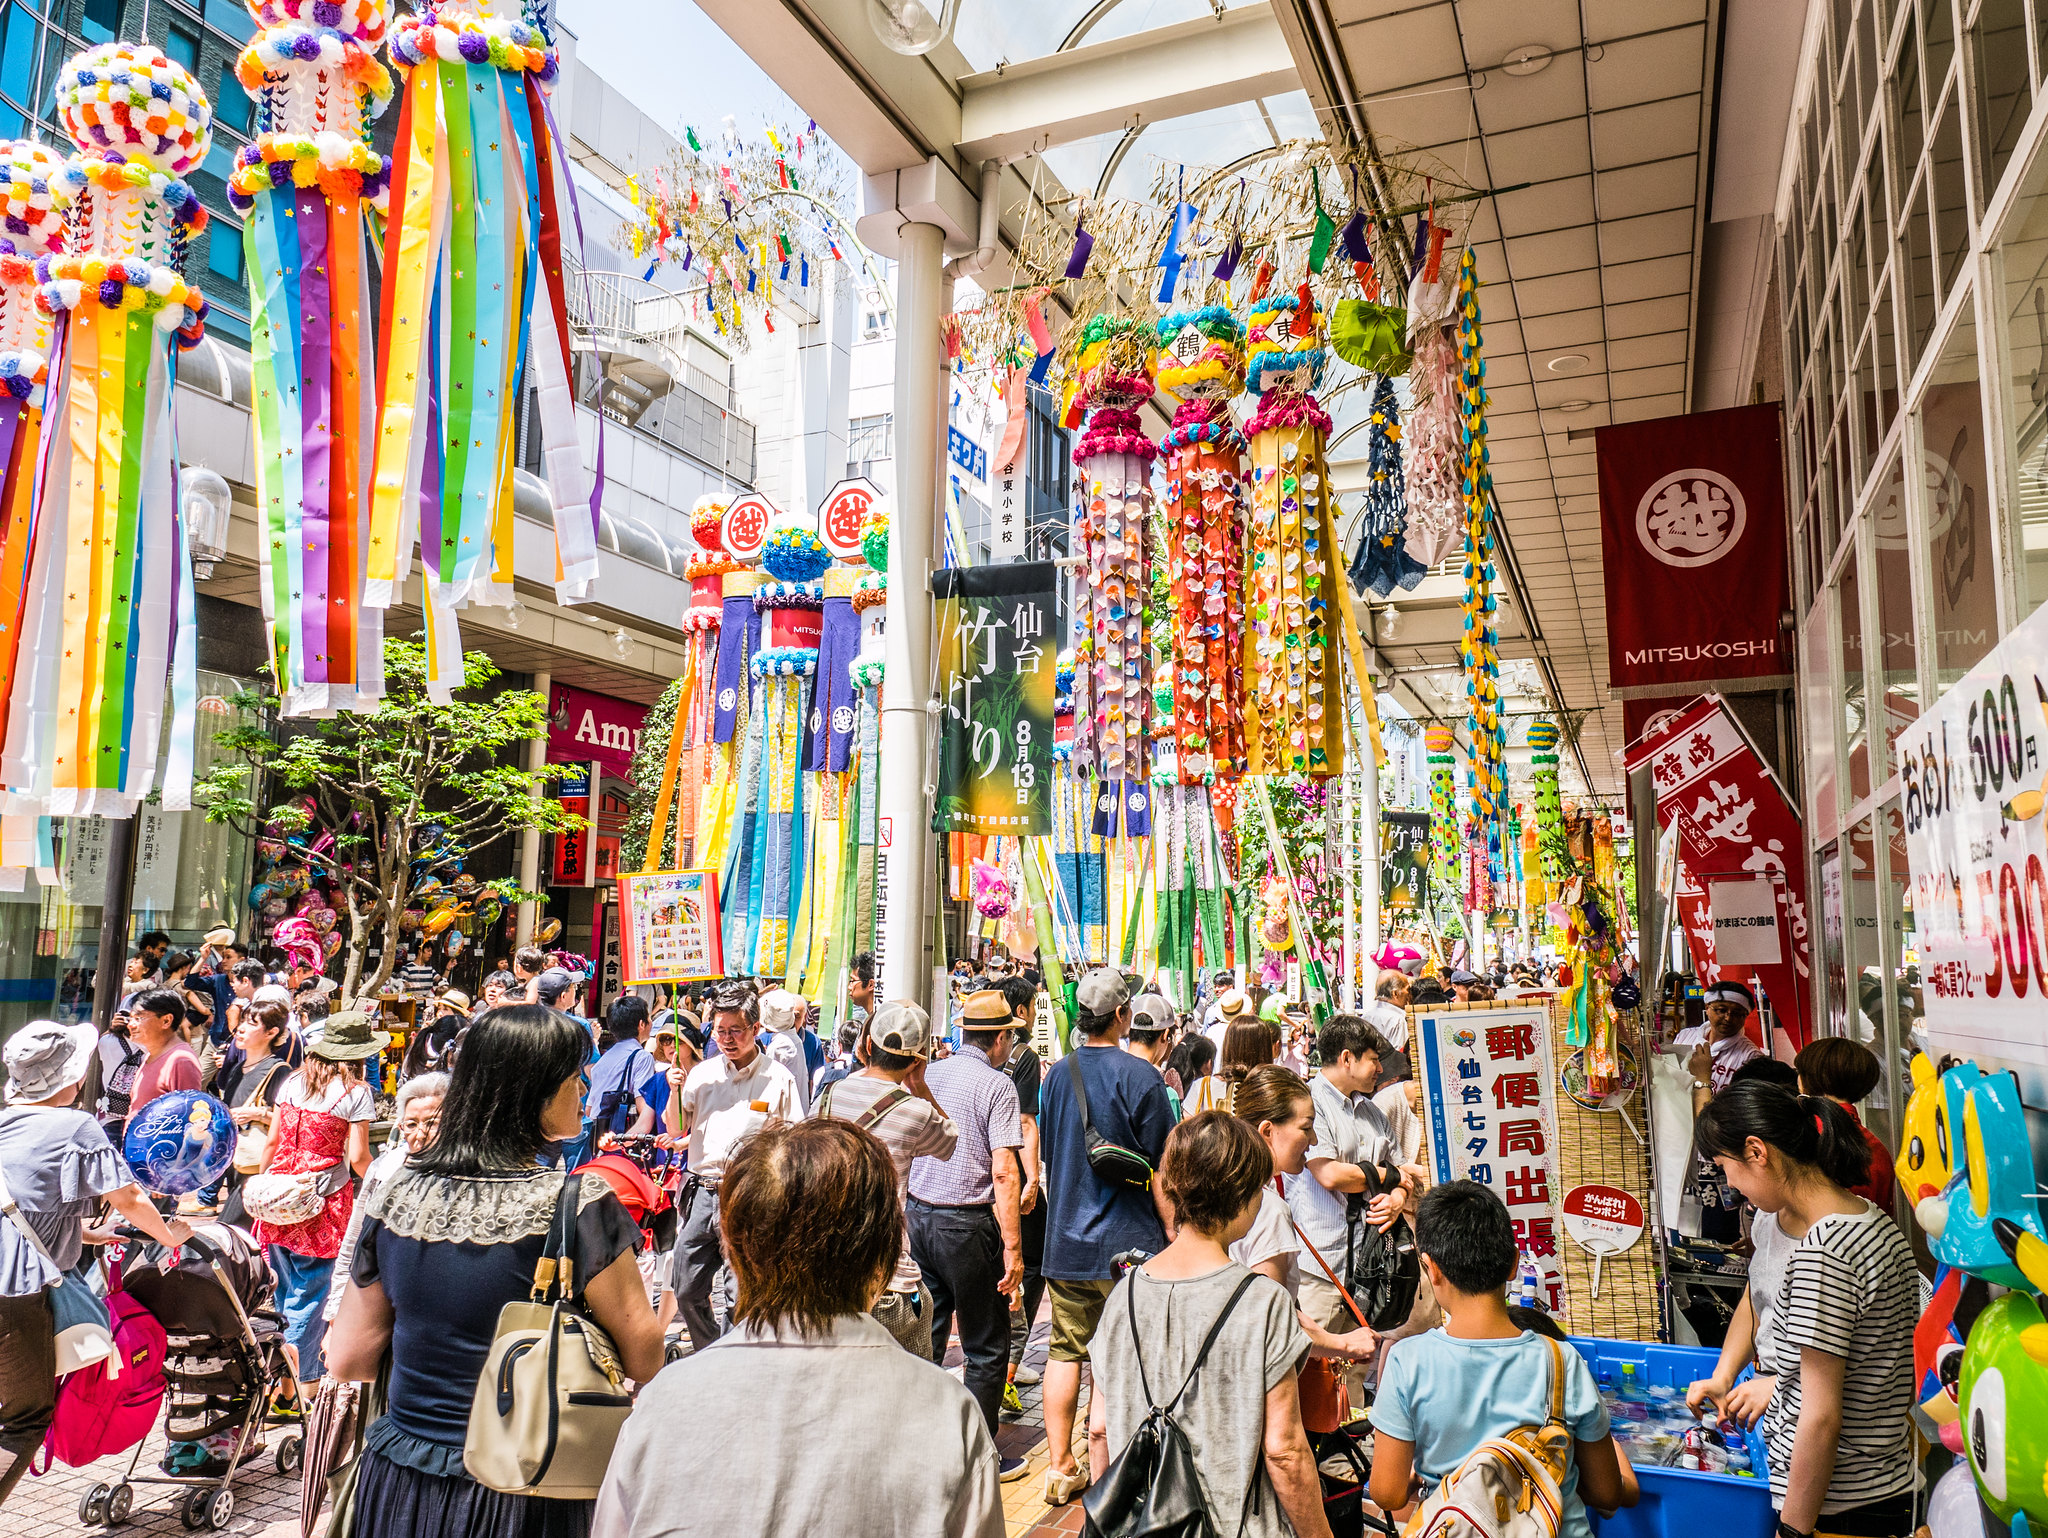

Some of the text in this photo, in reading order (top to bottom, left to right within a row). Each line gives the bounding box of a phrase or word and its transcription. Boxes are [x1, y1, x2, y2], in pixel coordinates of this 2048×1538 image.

[1176, 332, 1200, 359] 鶴
[1001, 462, 1014, 543] 谷東小学校
[1010, 602, 1044, 675] 仙台
[1625, 639, 1775, 665] MITSUKOSHI
[947, 606, 1008, 780] 竹灯り
[1011, 720, 1035, 805] 8月13日
[1653, 733, 1716, 787] 鐘崎
[1966, 674, 2039, 803] 600円
[1410, 826, 1424, 852] 仙台
[1669, 803, 1712, 850] 仙台名産
[1714, 915, 1775, 930] かまぼこの鐘崎
[1037, 998, 1048, 1057] 仙台三越
[1582, 1203, 1626, 1220] ニッポン!
[1583, 1192, 1627, 1210] がんばれ!
